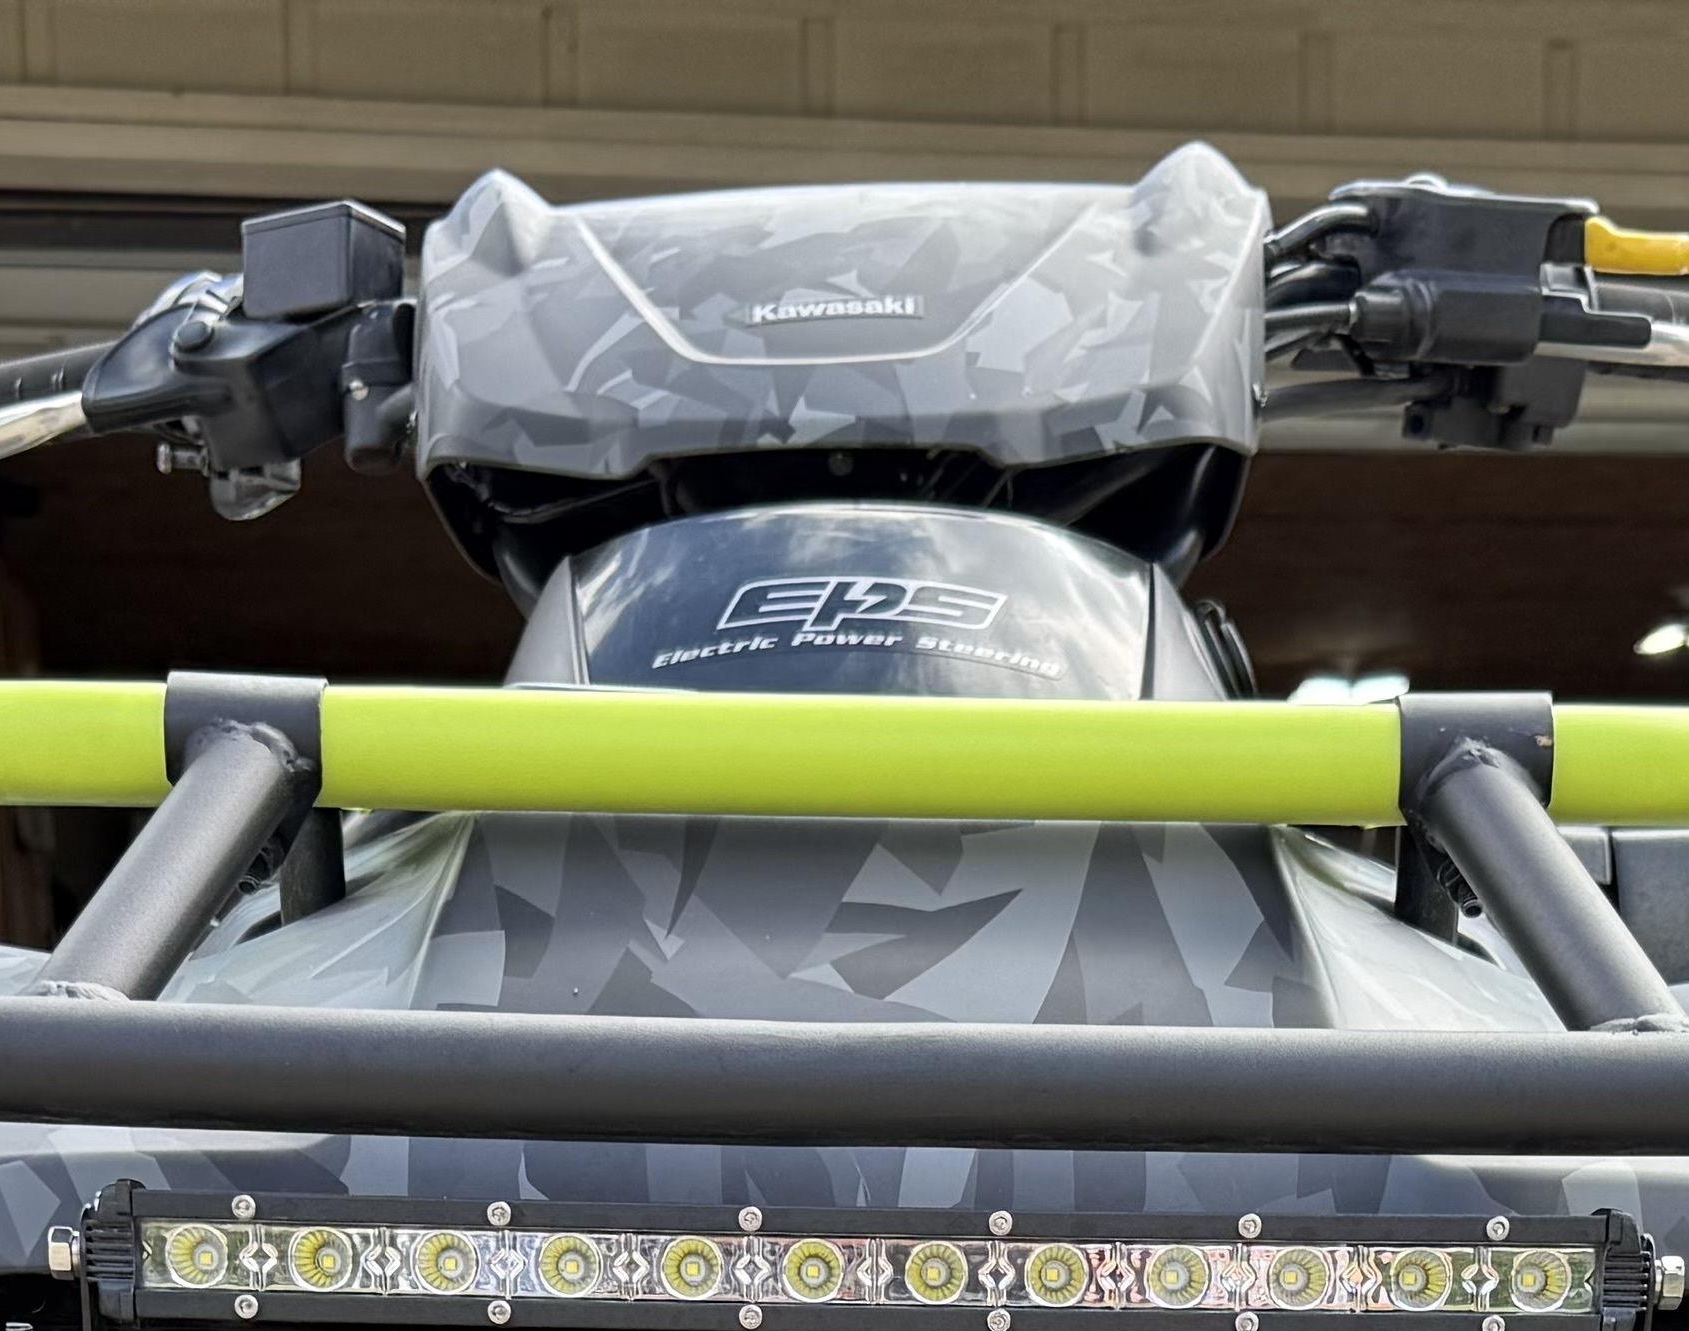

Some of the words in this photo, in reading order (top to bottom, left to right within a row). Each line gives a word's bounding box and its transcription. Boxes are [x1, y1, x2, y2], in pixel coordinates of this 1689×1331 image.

[752, 296, 914, 322] Kawasaki
[716, 575, 1008, 632] EPS
[652, 634, 779, 668] Electric
[791, 631, 903, 647] Power
[915, 635, 1064, 678] Steering
